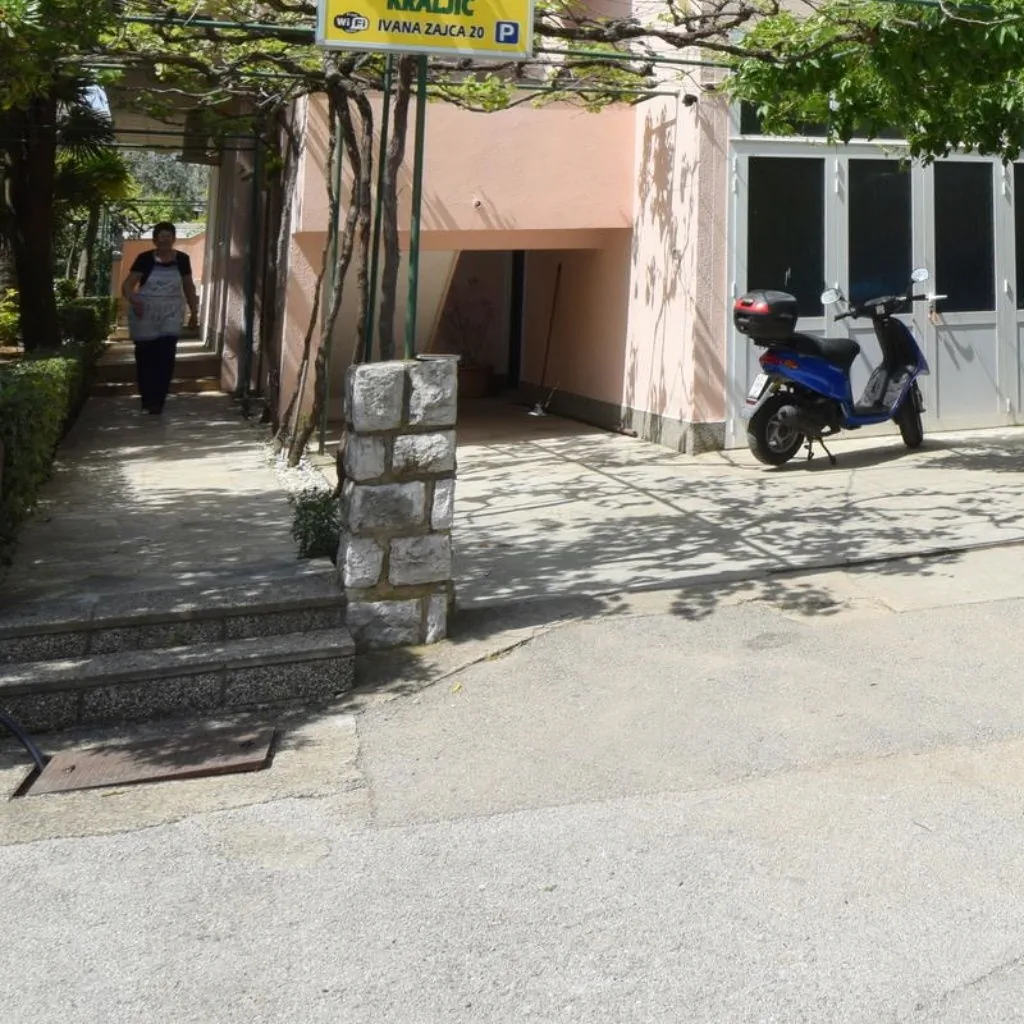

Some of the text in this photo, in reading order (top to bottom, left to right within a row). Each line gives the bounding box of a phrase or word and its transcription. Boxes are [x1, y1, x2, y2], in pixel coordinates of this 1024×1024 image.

[378, 19, 485, 39] IVANA ZAJCA 20
[499, 23, 515, 42] P
